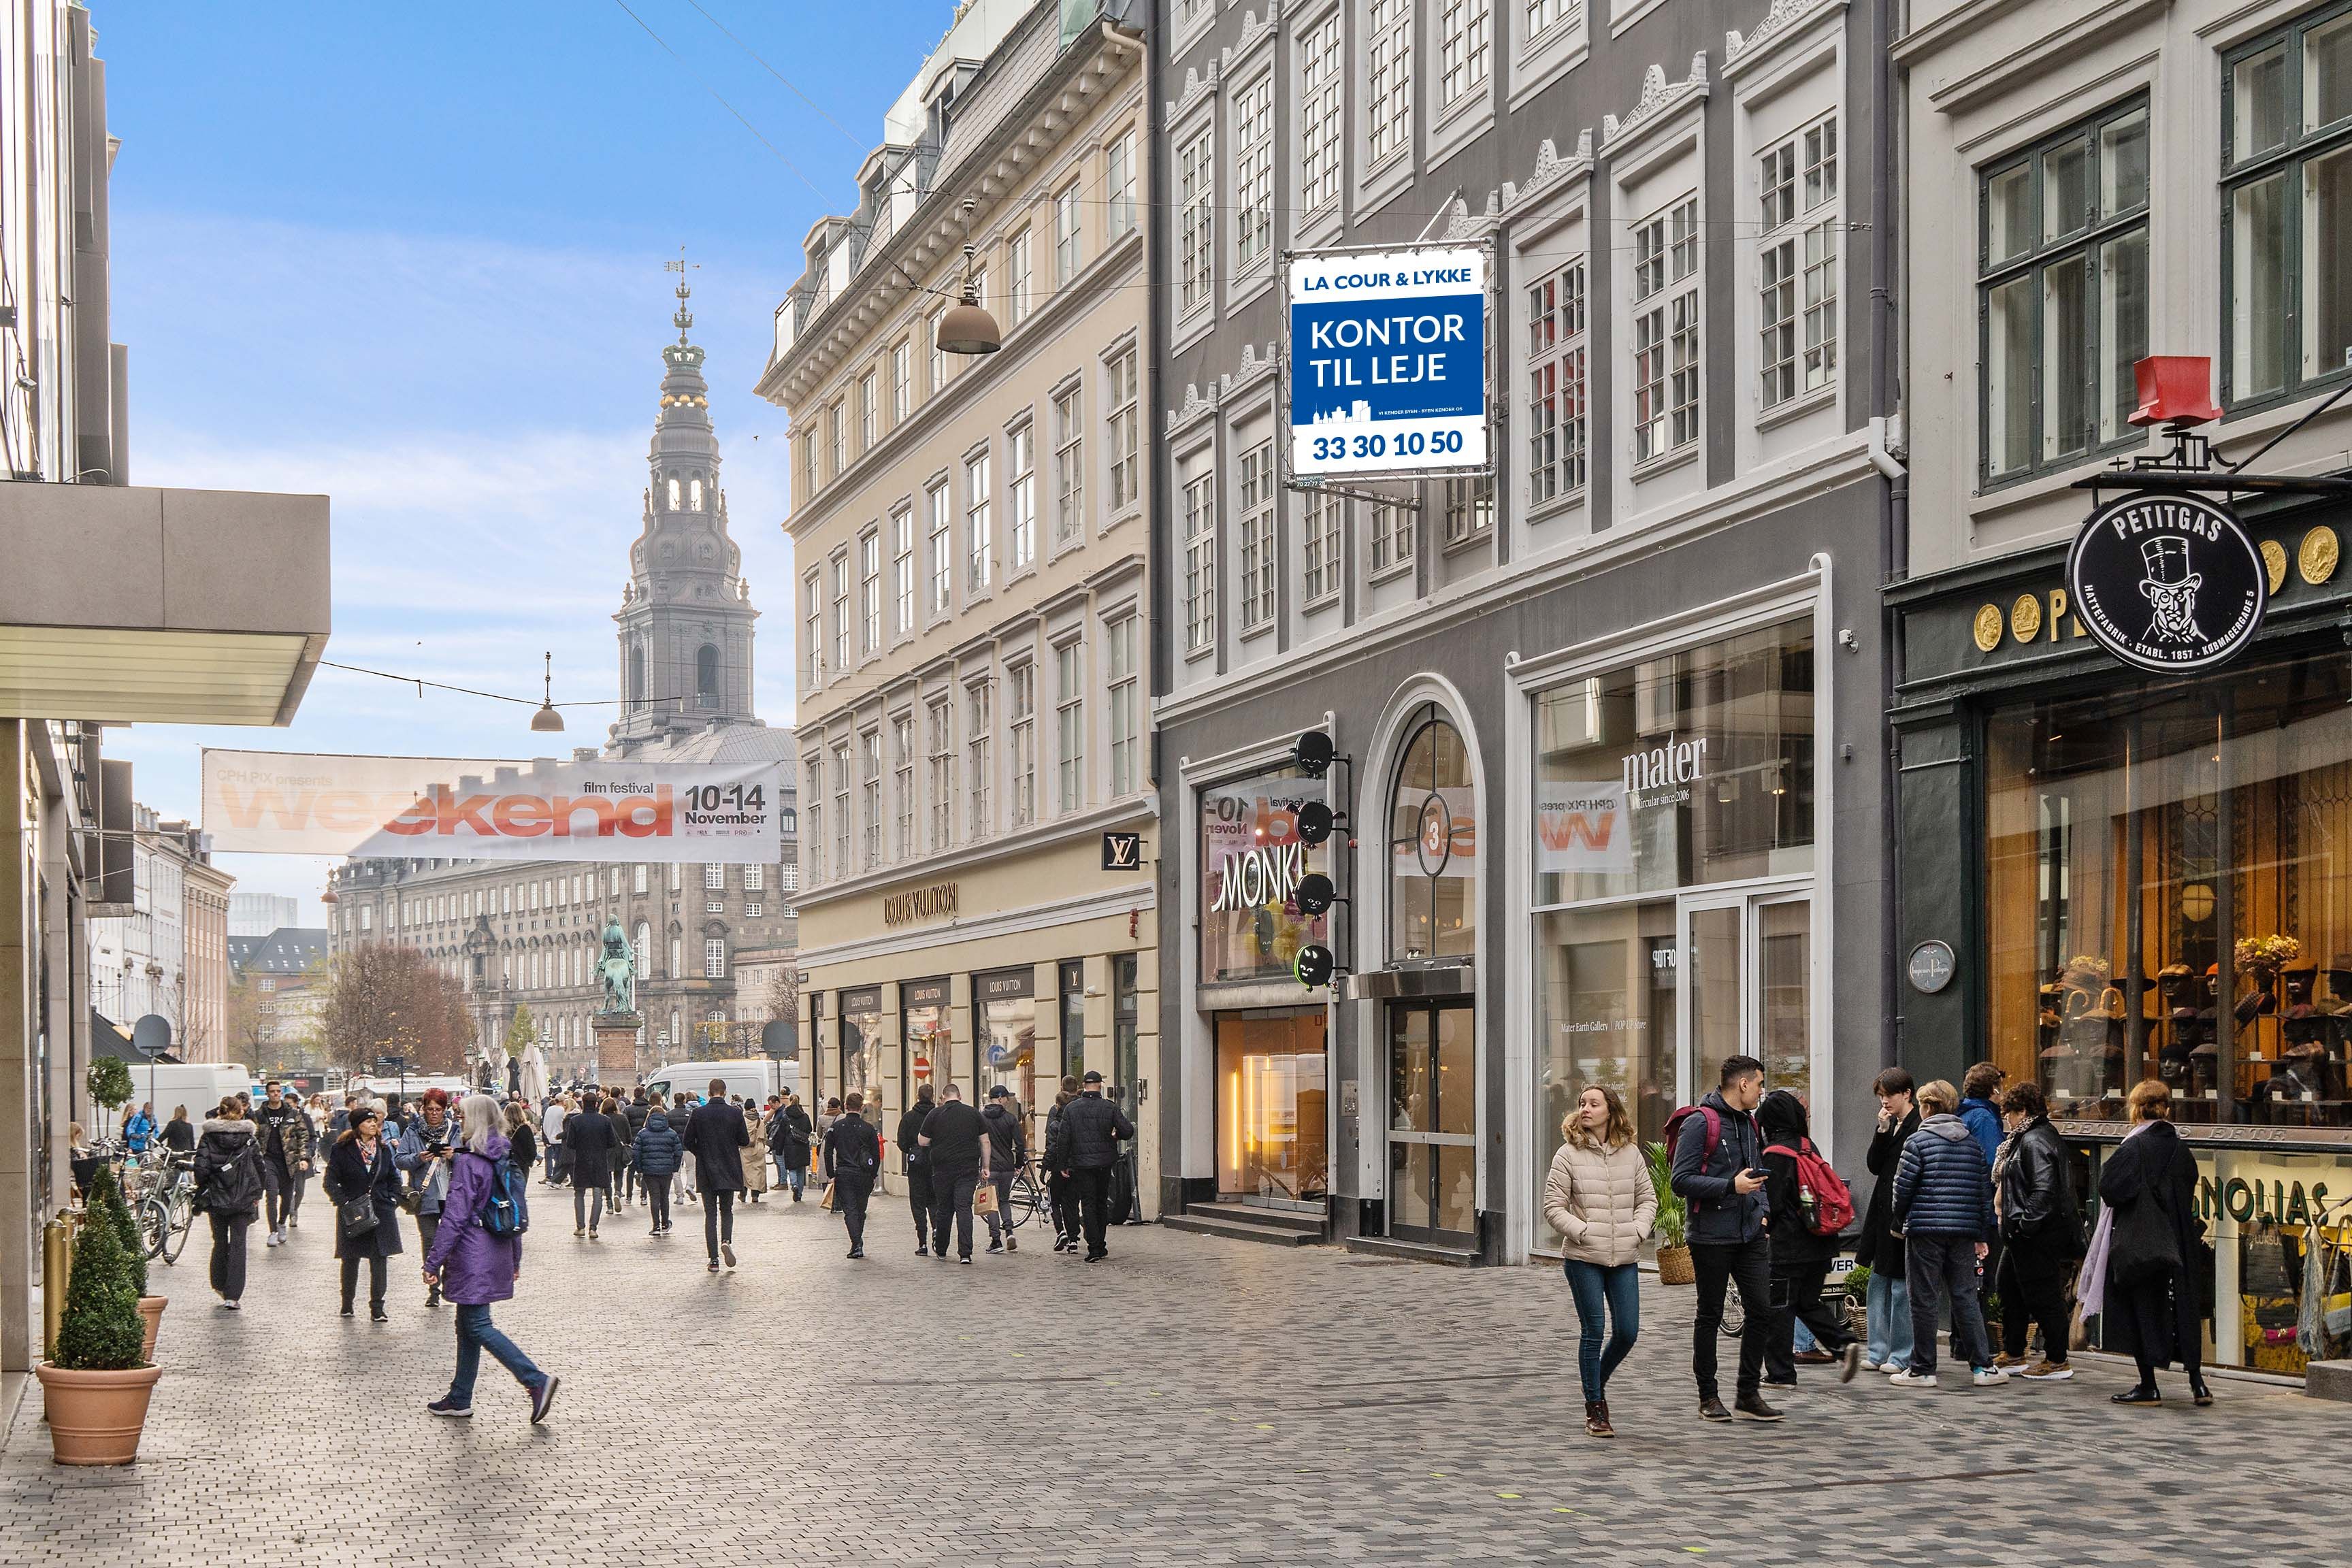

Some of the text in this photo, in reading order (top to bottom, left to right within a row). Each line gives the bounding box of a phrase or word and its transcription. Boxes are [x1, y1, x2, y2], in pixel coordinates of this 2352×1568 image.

[1304, 268, 1471, 291] LA COUR & LYKKE
[1311, 314, 1465, 349] KONTOR
[1309, 353, 1447, 387] TIL LEJE
[1313, 430, 1463, 460] 33 30 10 50
[2112, 504, 2222, 543] PETITGAS
[2085, 585, 2127, 644] HATTEFABRIK
[2135, 642, 2168, 659] ETABL.
[2172, 650, 2193, 659] 1857
[2202, 600, 2253, 655] KØBMAGERGADE
[1622, 731, 1707, 794] mater
[276, 775, 333, 787] presents
[583, 782, 654, 794] film festival
[685, 784, 766, 811] 10-14
[1660, 794, 1675, 804] since
[1676, 789, 1691, 802] 2006
[220, 783, 673, 838] weekend
[685, 812, 767, 824] November
[1429, 821, 1439, 850] 3
[885, 882, 958, 924] LOUIS VUITTON
[915, 987, 941, 1000] LOUIS VUITTON
[990, 979, 1021, 993] LOUIS VUITTON
[851, 996, 874, 1007] LOUIS VUITTON
[1561, 1023, 1575, 1032] Mater
[1575, 1022, 1589, 1032] Earth
[1590, 1021, 1608, 1033] Gallery
[1615, 1020, 1626, 1030] POP
